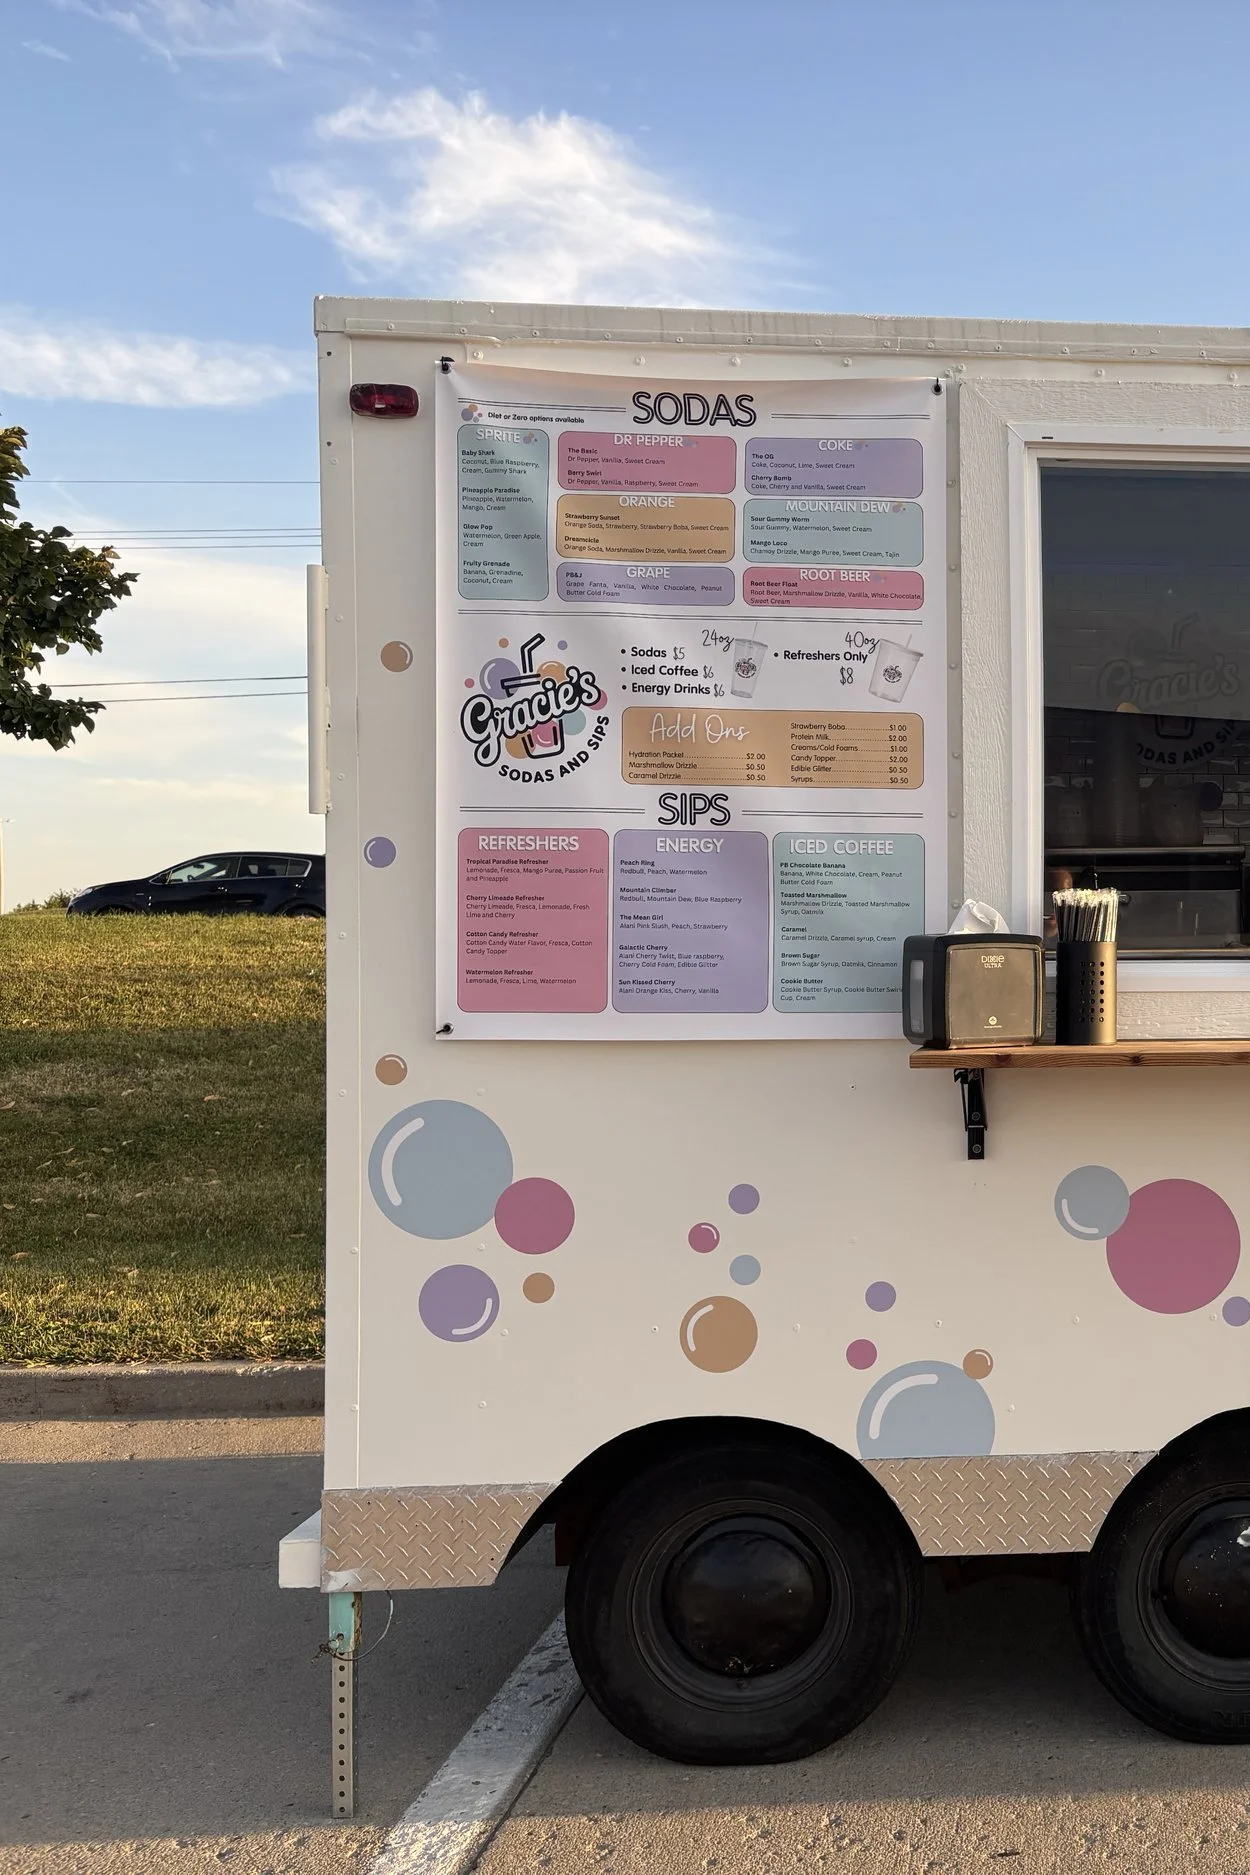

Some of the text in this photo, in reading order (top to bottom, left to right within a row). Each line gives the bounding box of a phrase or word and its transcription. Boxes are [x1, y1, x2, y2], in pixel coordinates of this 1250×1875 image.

[632, 391, 757, 427] SODAS
[529, 414, 553, 424] options
[554, 415, 585, 423] available
[476, 429, 521, 443] SPRITE
[613, 434, 683, 447] DR PEPPER
[818, 440, 853, 451] COKE
[461, 449, 477, 458] Baby
[751, 474, 792, 483] Cherry Bomb
[462, 487, 493, 496] Pineapple
[619, 496, 675, 508] ORANGE
[785, 500, 891, 513] MOUNTAIN DEW
[564, 513, 598, 522] Strawberry
[766, 516, 790, 524] Gummy
[480, 524, 493, 532] Pop
[750, 539, 771, 548] Mango
[463, 560, 481, 569] Fruity
[626, 567, 671, 579] GRAPE
[799, 569, 871, 582] ROOT BEER
[702, 629, 734, 652] 24oz
[845, 631, 880, 654] 40oz
[631, 646, 686, 661] Sodas $5
[783, 650, 868, 664] Refreshers Only
[631, 665, 714, 679] Iced Coffee $6
[840, 666, 854, 686] $8
[631, 683, 725, 698] Energy Drinks $6
[460, 666, 601, 767] Gracie's
[649, 712, 751, 744] Add Ons
[790, 722, 826, 732] Strawberry
[889, 724, 907, 732] $1.00
[888, 734, 908, 742] $2.00
[498, 715, 610, 783] SODAS AND SIPS
[890, 745, 908, 753] $1.00
[1183, 741, 1215, 764] AND
[628, 751, 661, 760] Hydration
[746, 753, 766, 761] $2.00
[790, 754, 812, 763] Candy
[889, 756, 908, 764] $2.00
[628, 761, 674, 769] Marshmallow
[746, 763, 766, 771] $0.50
[889, 766, 908, 774] $0.50
[628, 772, 657, 780] Caramel
[746, 774, 766, 782] $0.50
[658, 792, 731, 826] SIPS
[478, 836, 579, 851] REFRESHERS
[656, 837, 724, 853] ENERGY
[790, 839, 894, 855] ICED COFFEE
[466, 858, 490, 866] Tropical
[640, 859, 655, 867] Ring
[466, 894, 487, 903] Cherry
[488, 931, 508, 939] Candy
[646, 944, 668, 952] Cherry
[802, 952, 820, 960] Sugar
[653, 979, 676, 987] Cherry
